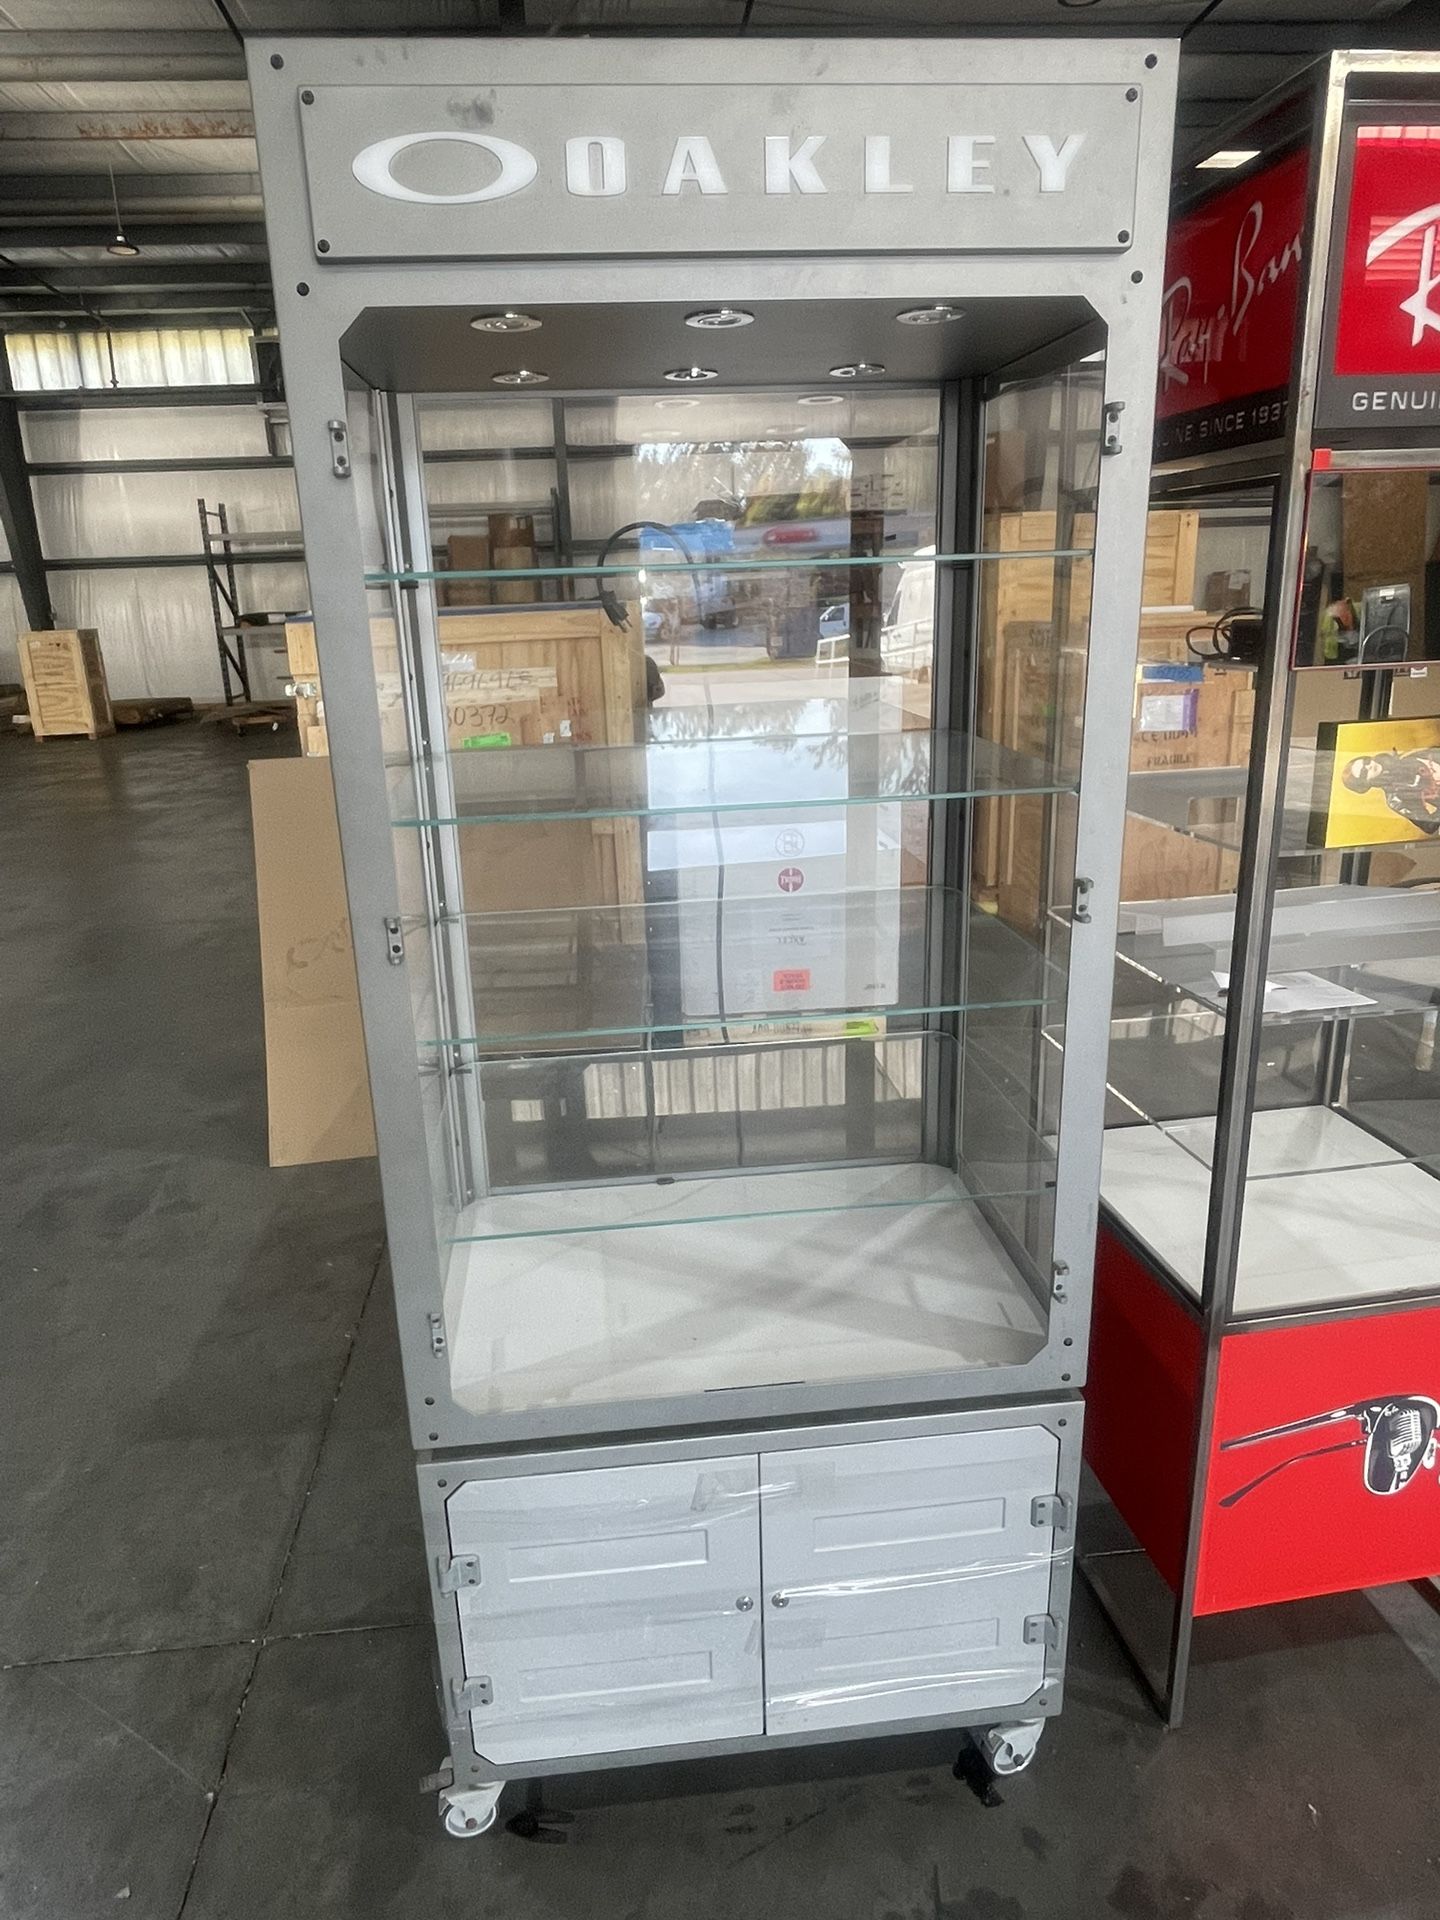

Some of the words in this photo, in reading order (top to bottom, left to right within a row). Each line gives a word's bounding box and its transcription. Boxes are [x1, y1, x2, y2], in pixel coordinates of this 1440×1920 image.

[565, 133, 1087, 197] OAKLEY
[1352, 390, 1440, 411] GENUI
[1199, 410, 1246, 438] SINCE
